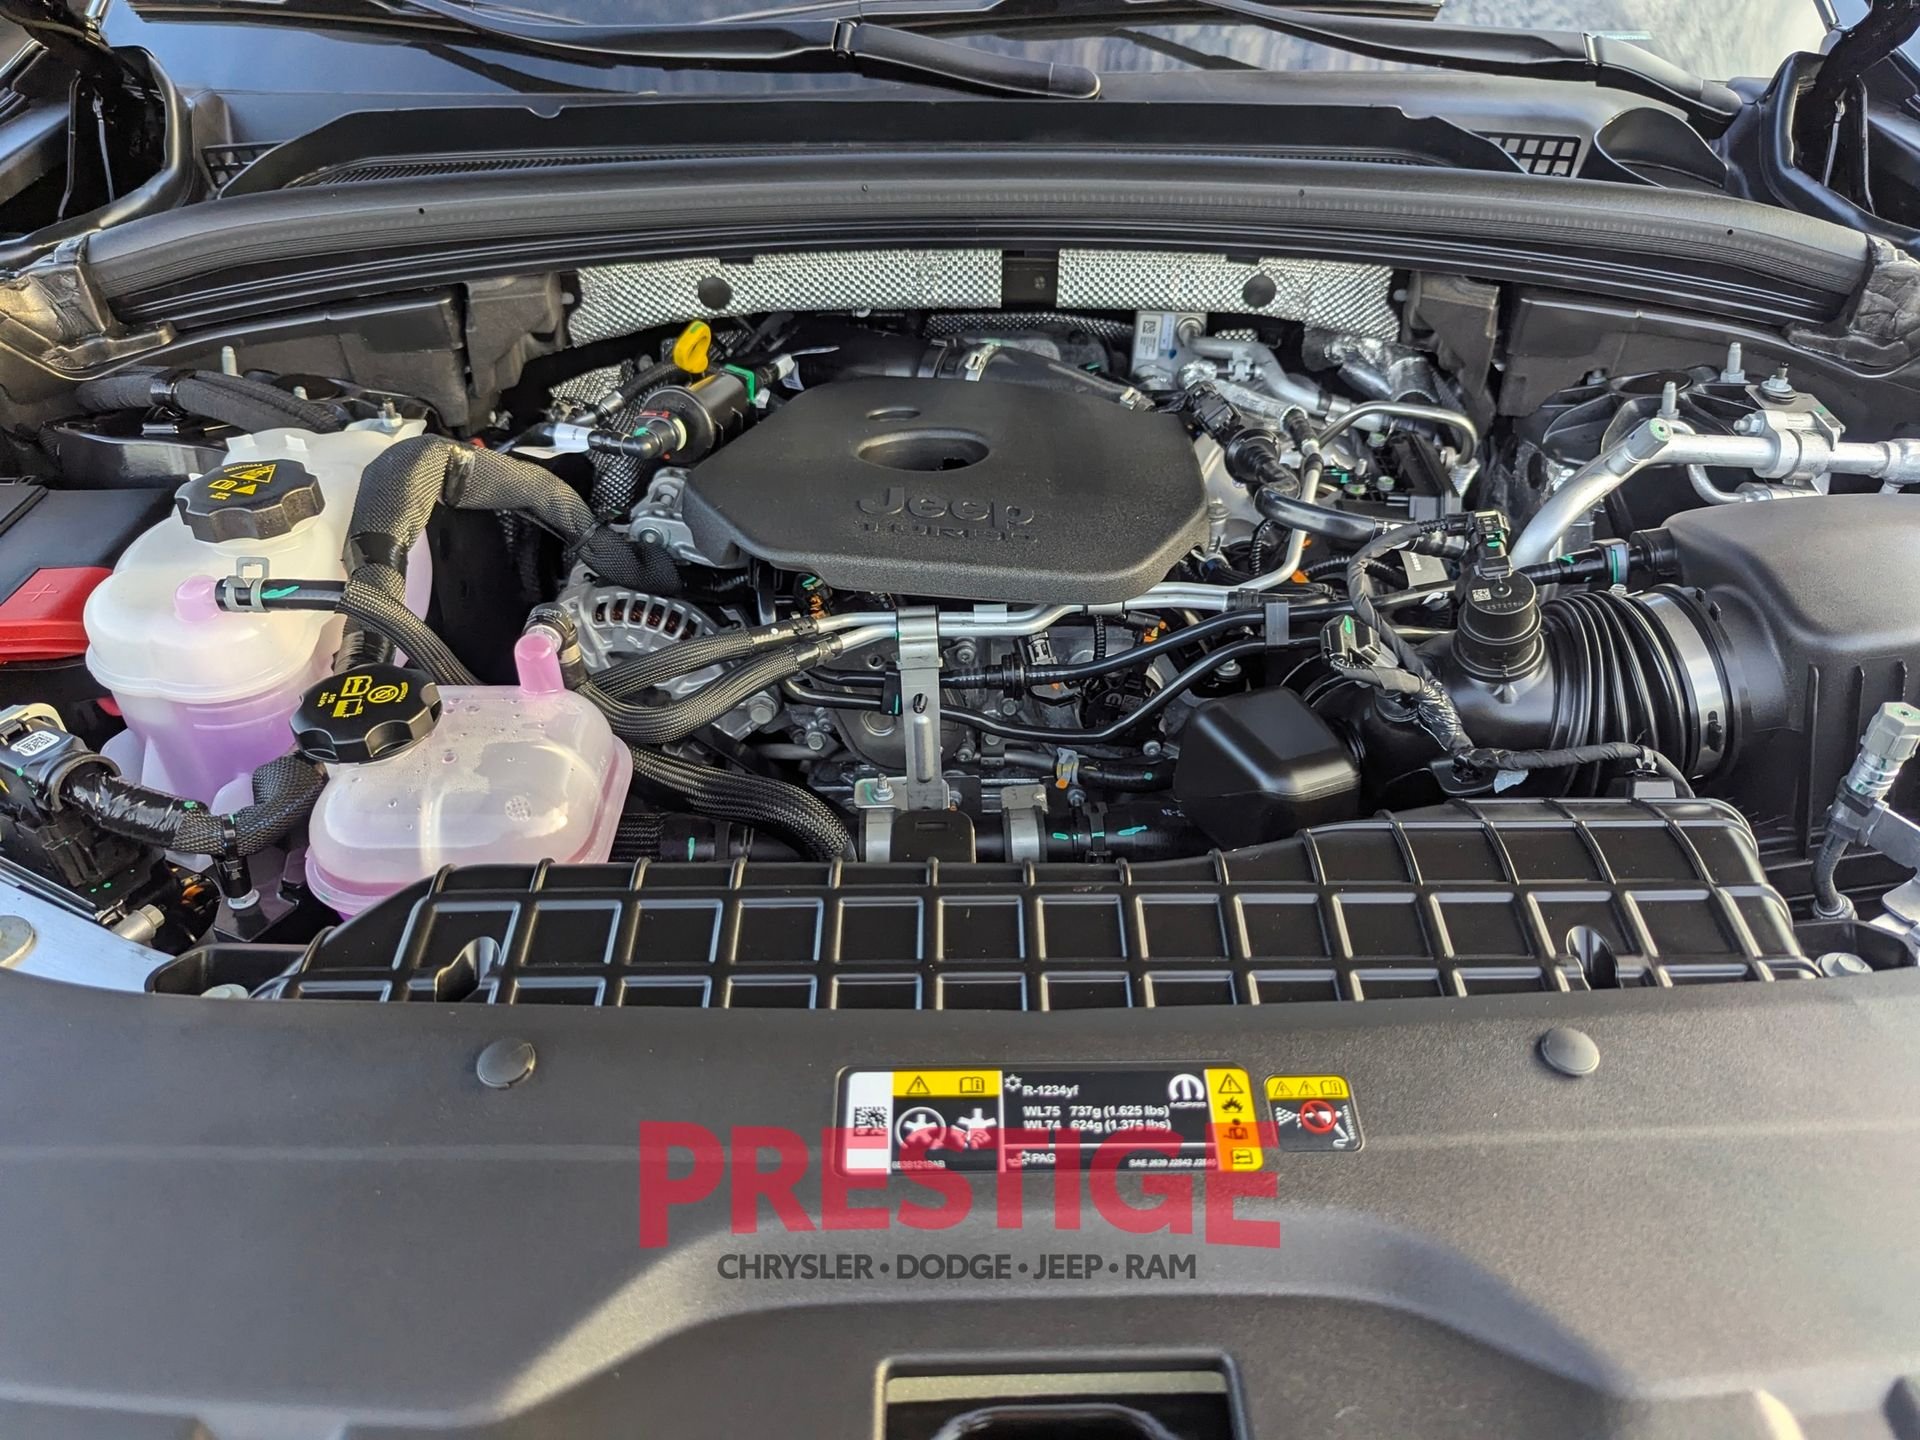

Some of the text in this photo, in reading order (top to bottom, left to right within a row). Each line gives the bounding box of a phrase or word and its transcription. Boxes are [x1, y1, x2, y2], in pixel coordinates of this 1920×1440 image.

[856, 487, 1035, 529] Jeep
[1022, 1085, 1079, 1099] R-1234yf
[1023, 1104, 1170, 1119] WL75 737g (1.625 lbs)
[1023, 1119, 1172, 1133] WL74 624g (1.375 lbs)
[1031, 1152, 1056, 1164] PAG
